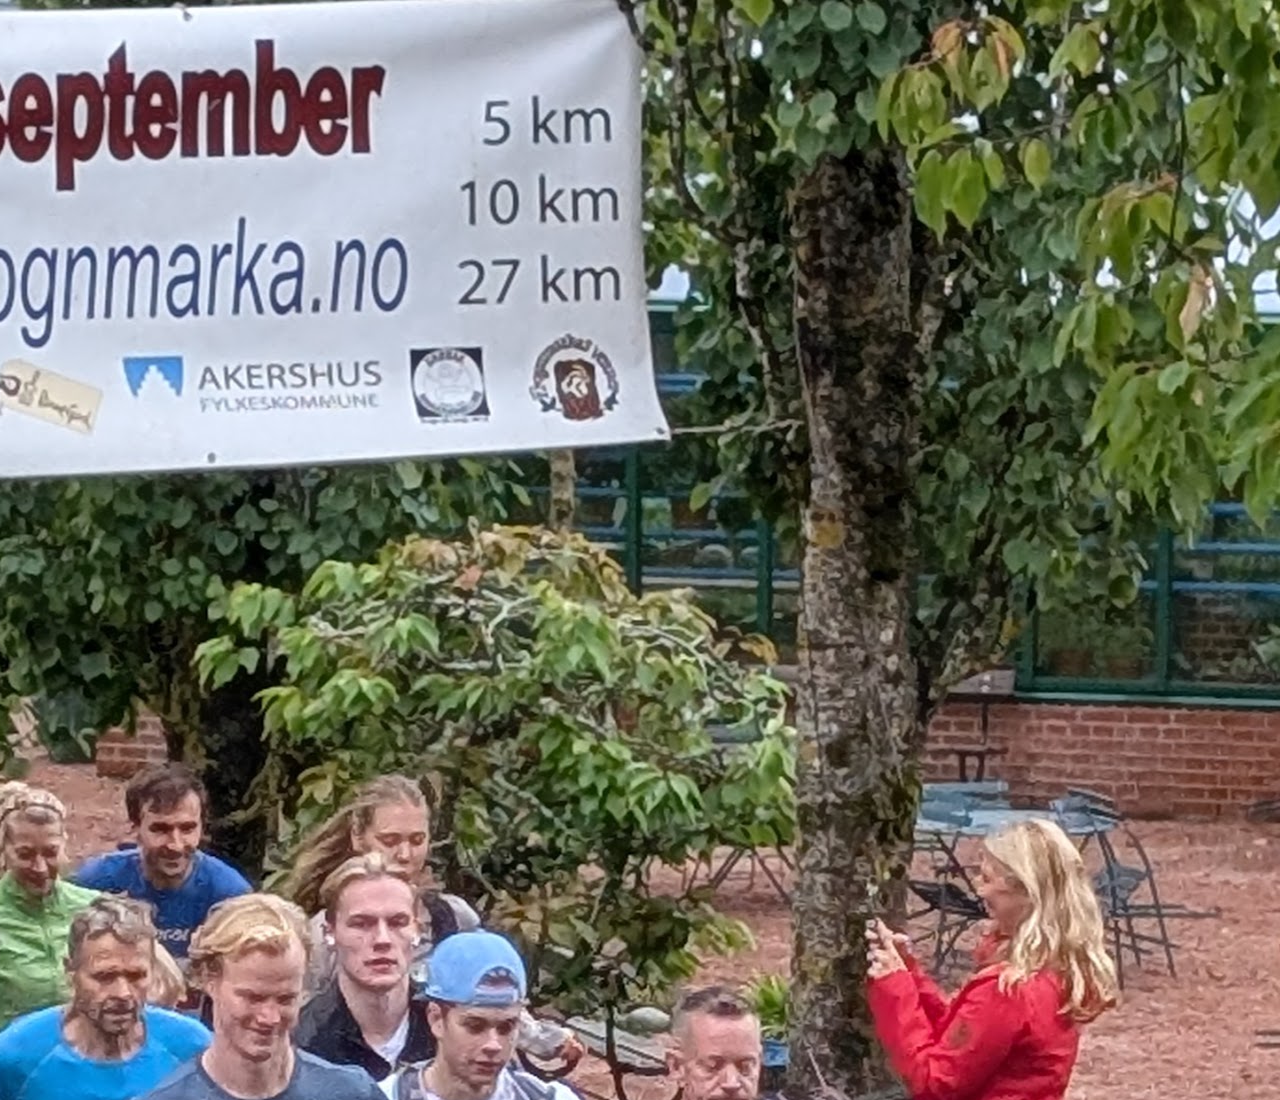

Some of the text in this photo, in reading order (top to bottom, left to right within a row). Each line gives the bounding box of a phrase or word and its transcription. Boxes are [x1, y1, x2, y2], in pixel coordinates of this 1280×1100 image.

[483, 96, 612, 145] 5 km
[460, 174, 620, 225] 10 km
[458, 255, 621, 305] 27 km
[198, 360, 382, 390] AKERSHUS
[199, 393, 380, 413] FYLKESKOMMUNE
